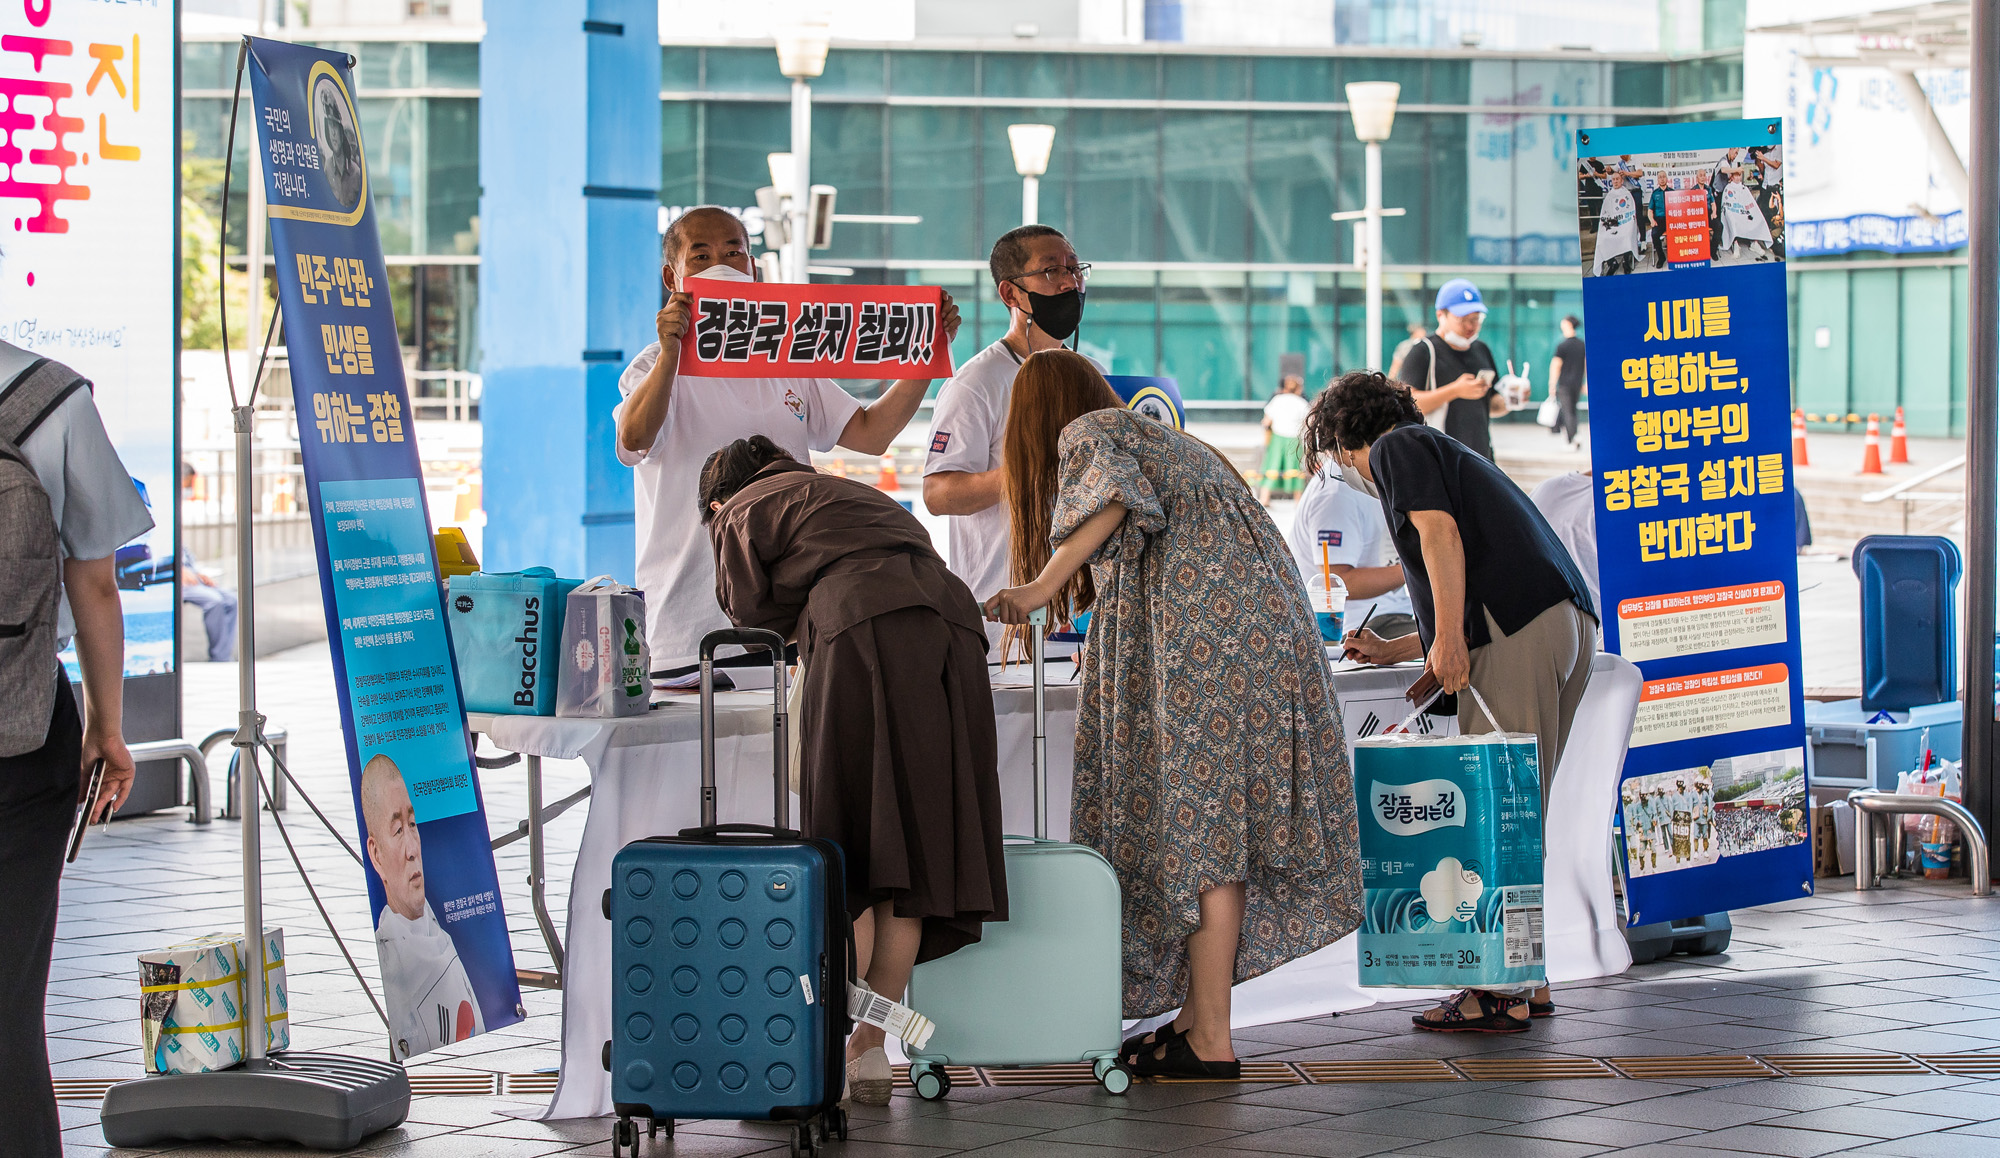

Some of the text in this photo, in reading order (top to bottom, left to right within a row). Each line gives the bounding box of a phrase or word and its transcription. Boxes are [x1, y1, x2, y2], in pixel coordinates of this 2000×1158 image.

[86, 33, 141, 161] 진
[264, 107, 292, 134] 국민의
[269, 138, 320, 170] 생명과 인권을
[273, 171, 310, 199] 지킵니다.
[695, 297, 937, 365] 경찰국 설치 철회!!
[1643, 295, 1731, 342] 시대를
[320, 324, 375, 375] 민생을
[1621, 351, 1749, 398] 역행하는,
[313, 390, 405, 444] 위하는 경찰
[1632, 402, 1749, 453] 행안부의
[1603, 453, 1784, 512] 경찰국 설치를
[1638, 510, 1756, 562] 반대한다
[1621, 601, 1643, 613] 법무부도
[1692, 592, 1715, 604] 행안부의
[1716, 590, 1733, 601] 경찰국
[1734, 588, 1751, 599] 신설이
[1752, 587, 1758, 597] 왜
[513, 596, 540, 707] Bacchus
[1648, 683, 1665, 695] 경찰국
[1666, 681, 1682, 692] 설치는
[1683, 678, 1700, 690] 경찰의
[1720, 672, 1742, 685] 중립성을
[1377, 791, 1455, 824] 잘풀리는집
[1381, 861, 1404, 876] 데코
[1507, 892, 1514, 903] 51
